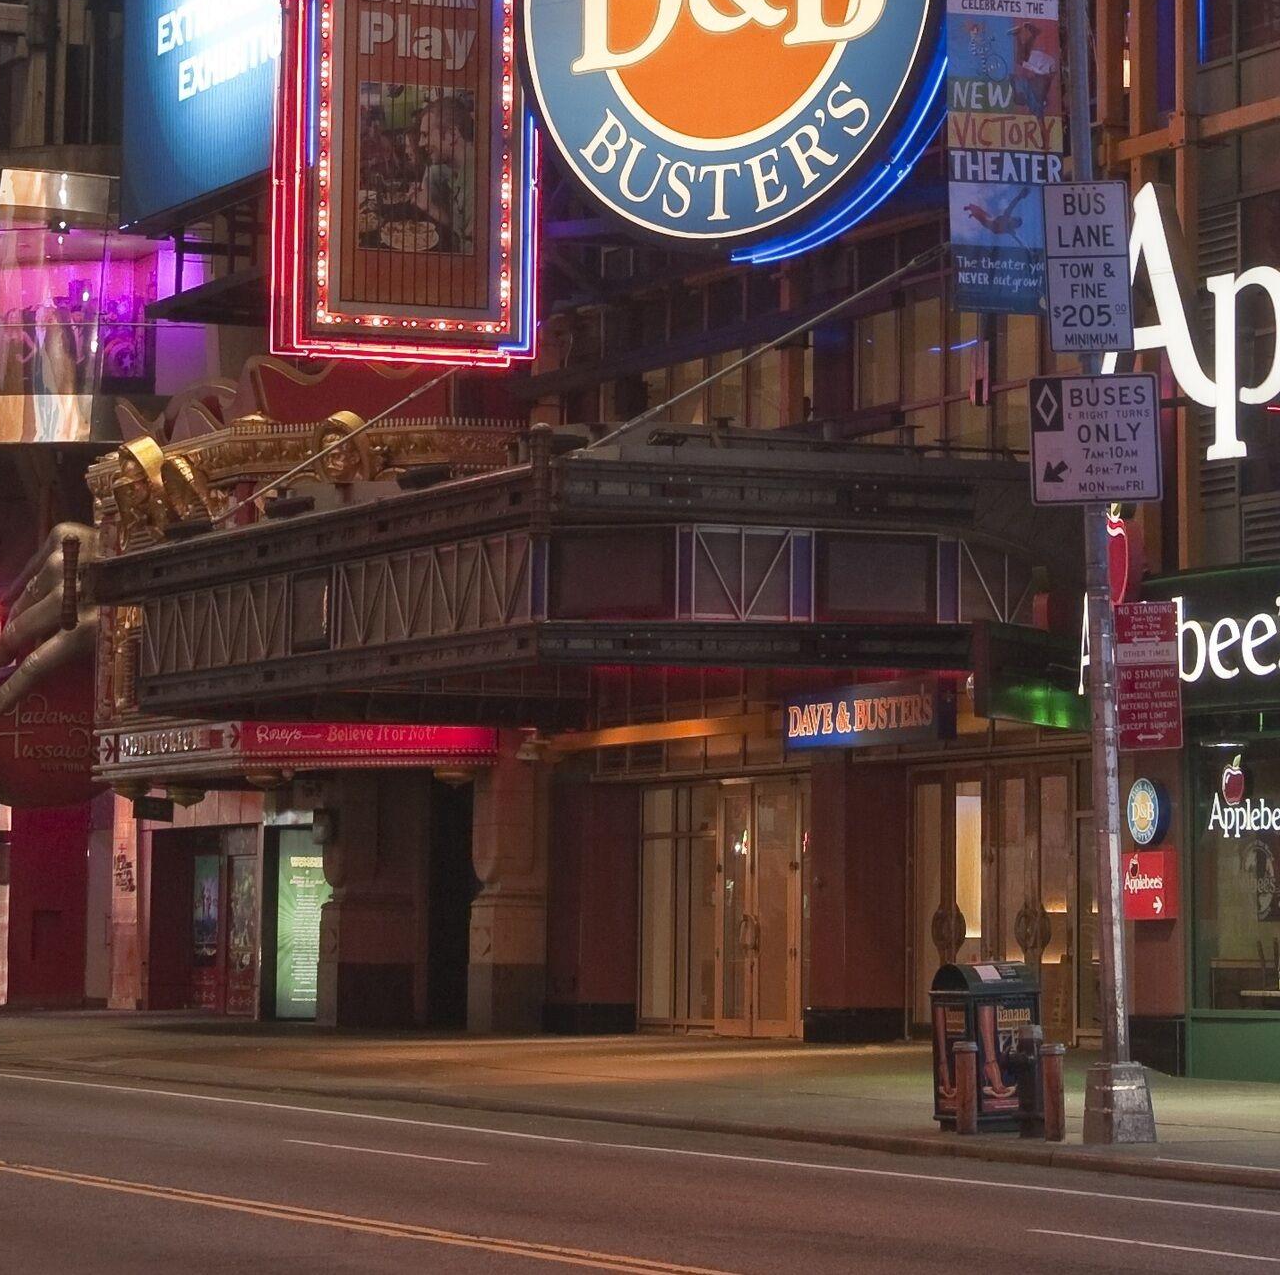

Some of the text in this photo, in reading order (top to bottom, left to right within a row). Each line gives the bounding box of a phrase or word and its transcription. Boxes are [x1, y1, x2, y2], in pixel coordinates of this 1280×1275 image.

[1025, 2, 1044, 14] THE
[360, 11, 475, 70] Play
[953, 81, 1014, 109] NEW
[952, 115, 1056, 150] VICTORY
[579, 80, 871, 222] BUSTER'S
[950, 150, 1063, 183] THEATER
[1063, 193, 1106, 215] BUS
[1058, 225, 1115, 248] LANE
[956, 256, 1025, 270] The theater
[1060, 262, 1115, 279] TOW &
[958, 272, 989, 285] NEVER
[1071, 283, 1107, 299] FINE
[1064, 333, 1118, 345] MINIMUM
[1070, 386, 1146, 407] BUSES
[1079, 409, 1150, 419] RIGHT TURNS
[1077, 422, 1142, 444] ONLY
[1078, 482, 1105, 493] MON
[1125, 480, 1144, 491] FRI
[1118, 605, 1172, 615] NO STANDING
[1123, 650, 1146, 658] OTHER
[1120, 669, 1175, 680] NO STANDING
[1134, 681, 1161, 690] EXCEPT
[788, 702, 833, 737] DAVE
[836, 701, 851, 733] &
[327, 727, 374, 743] Believe
[377, 726, 390, 741] It
[392, 729, 406, 741] or
[1131, 802, 1155, 822] D&B
